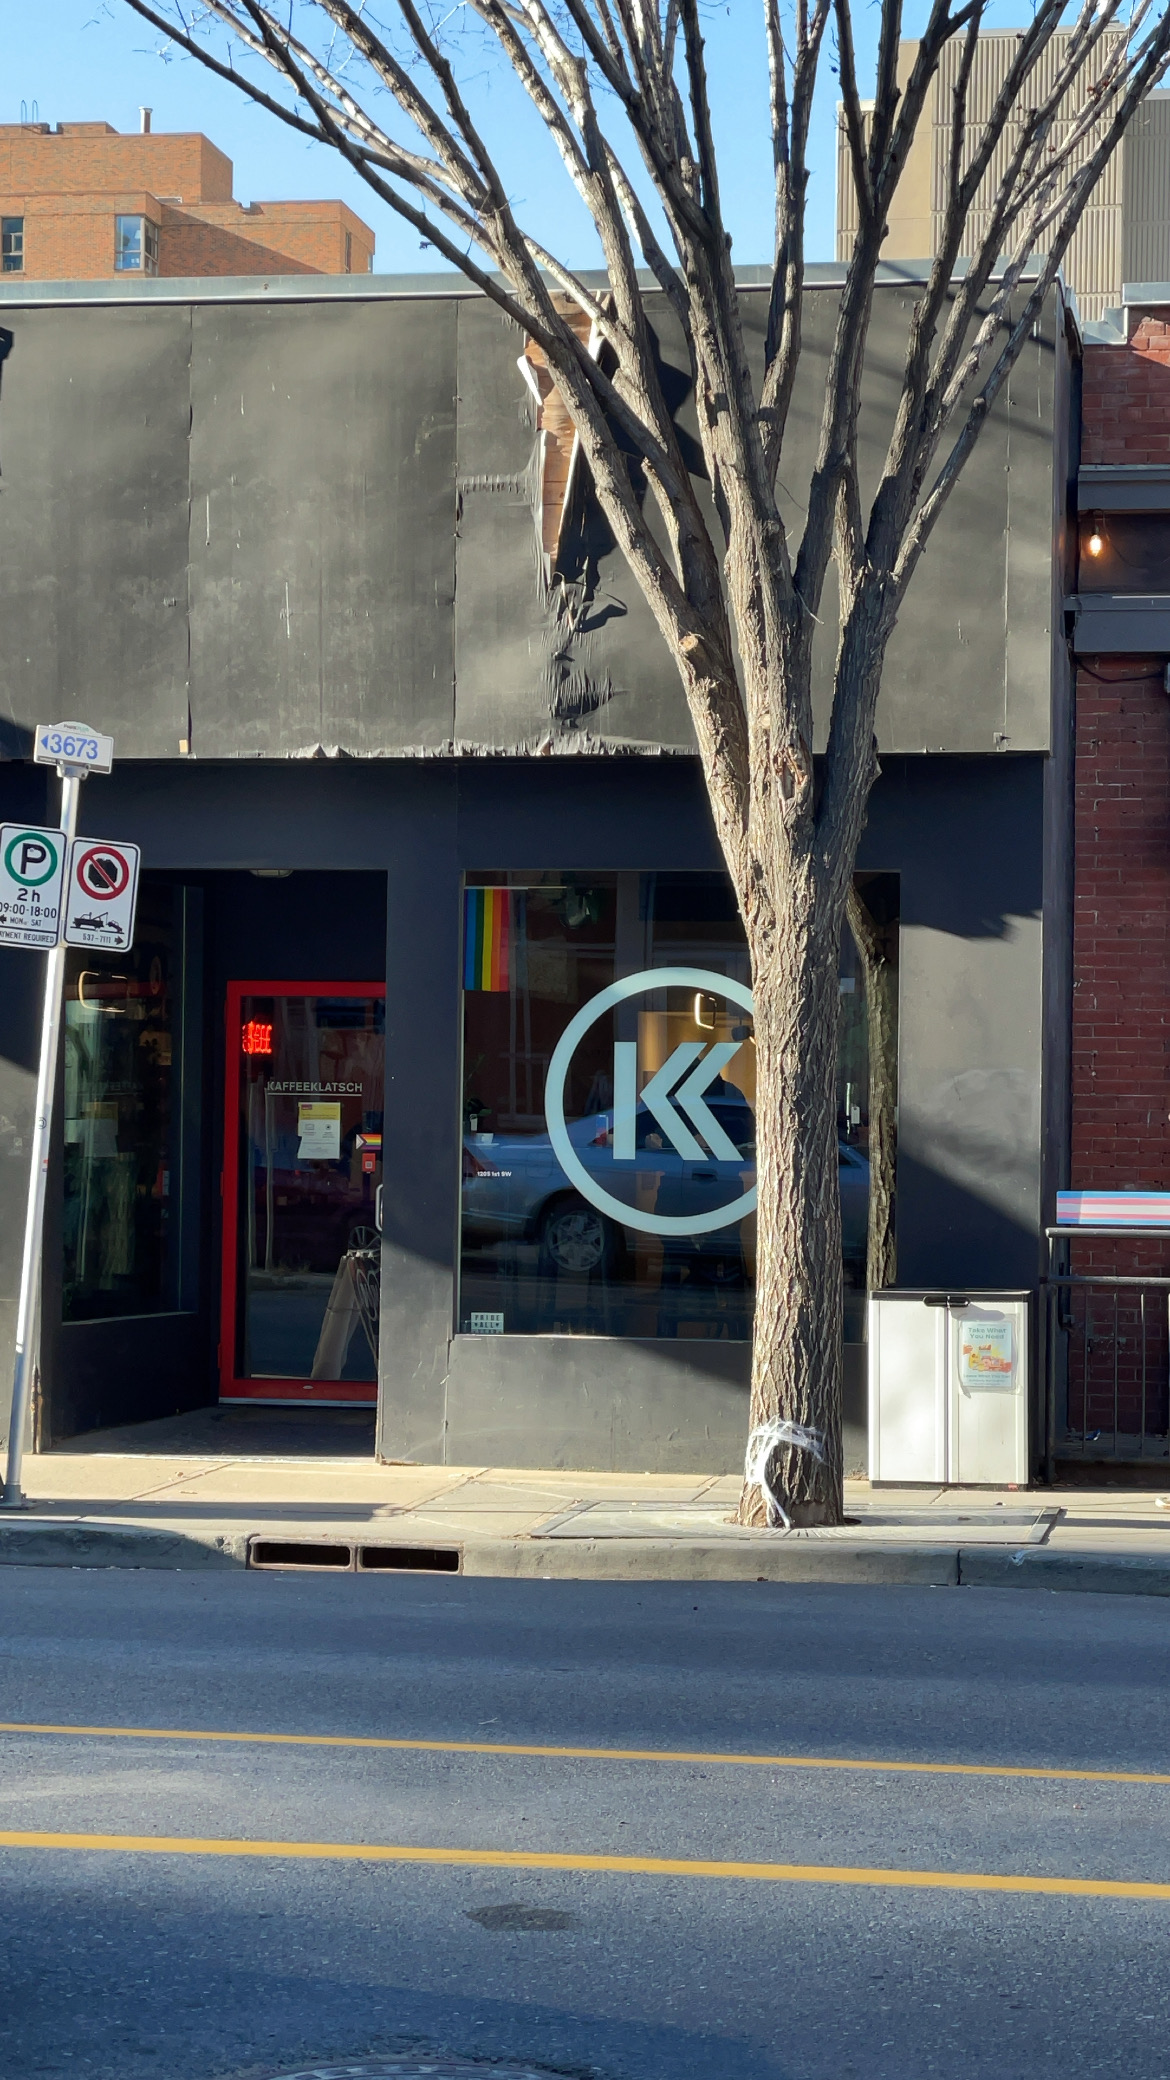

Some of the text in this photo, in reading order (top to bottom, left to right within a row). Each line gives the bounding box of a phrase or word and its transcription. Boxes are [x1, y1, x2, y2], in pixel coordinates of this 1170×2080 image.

[50, 733, 98, 760] 3673
[20, 843, 47, 875] P
[17, 888, 40, 903] 2 h
[31, 919, 42, 927] SAT
[24, 933, 55, 943] REQUIRED
[266, 1081, 363, 1093] KAFFEEKLATSCH
